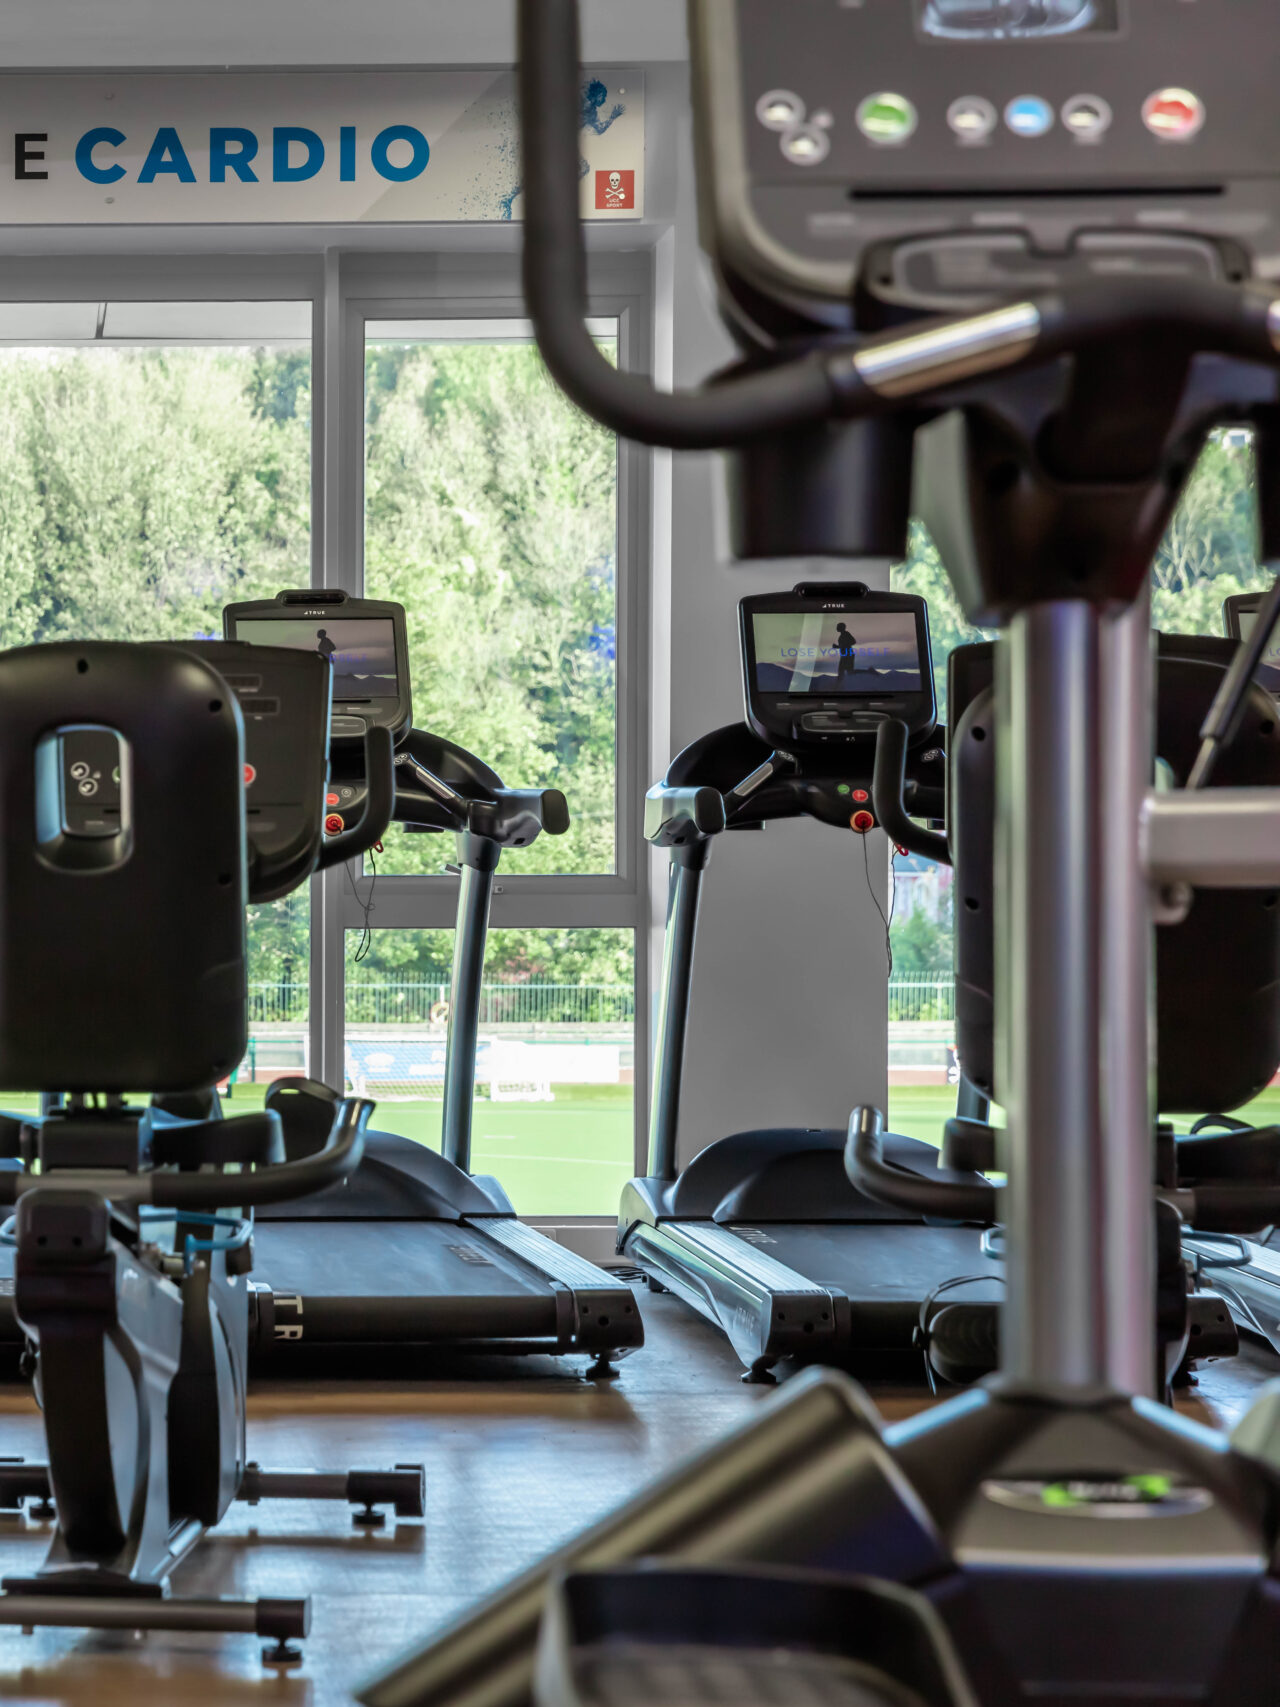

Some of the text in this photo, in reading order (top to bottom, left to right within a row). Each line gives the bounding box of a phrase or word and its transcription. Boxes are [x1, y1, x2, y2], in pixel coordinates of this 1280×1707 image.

[75, 124, 430, 184] CARDIO
[781, 648, 890, 657] LOSE YOURSELF
